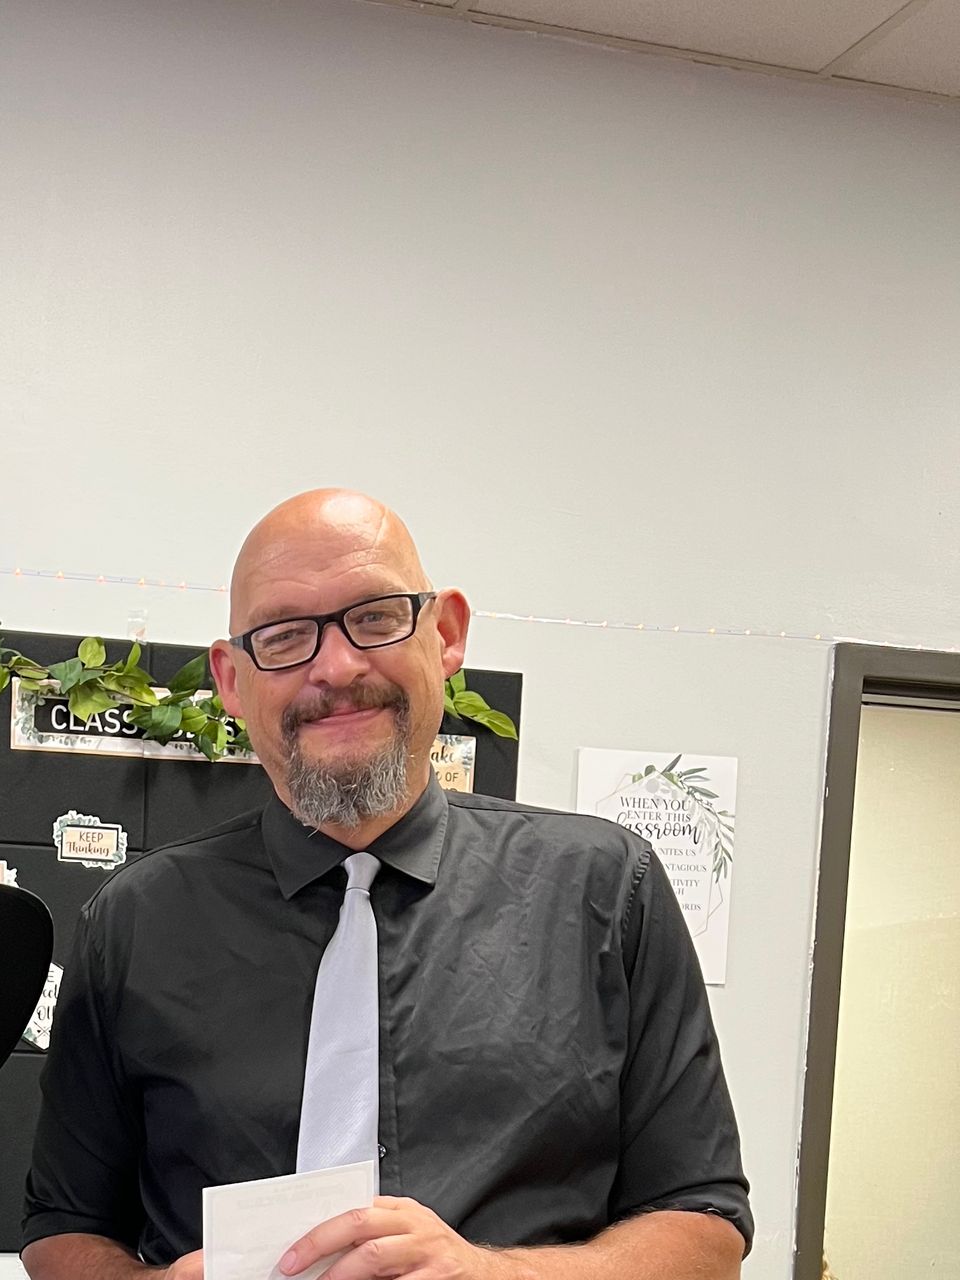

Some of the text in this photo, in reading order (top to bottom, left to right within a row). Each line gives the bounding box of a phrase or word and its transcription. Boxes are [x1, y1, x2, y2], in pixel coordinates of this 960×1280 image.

[431, 745, 455, 763] ake
[445, 772, 459, 782] OF
[620, 796, 690, 812] WHEN YOU
[628, 810, 692, 823] ENTER THIS
[80, 831, 104, 843] KEEP
[66, 841, 110, 857] Thinking
[658, 848, 697, 857] NITES US
